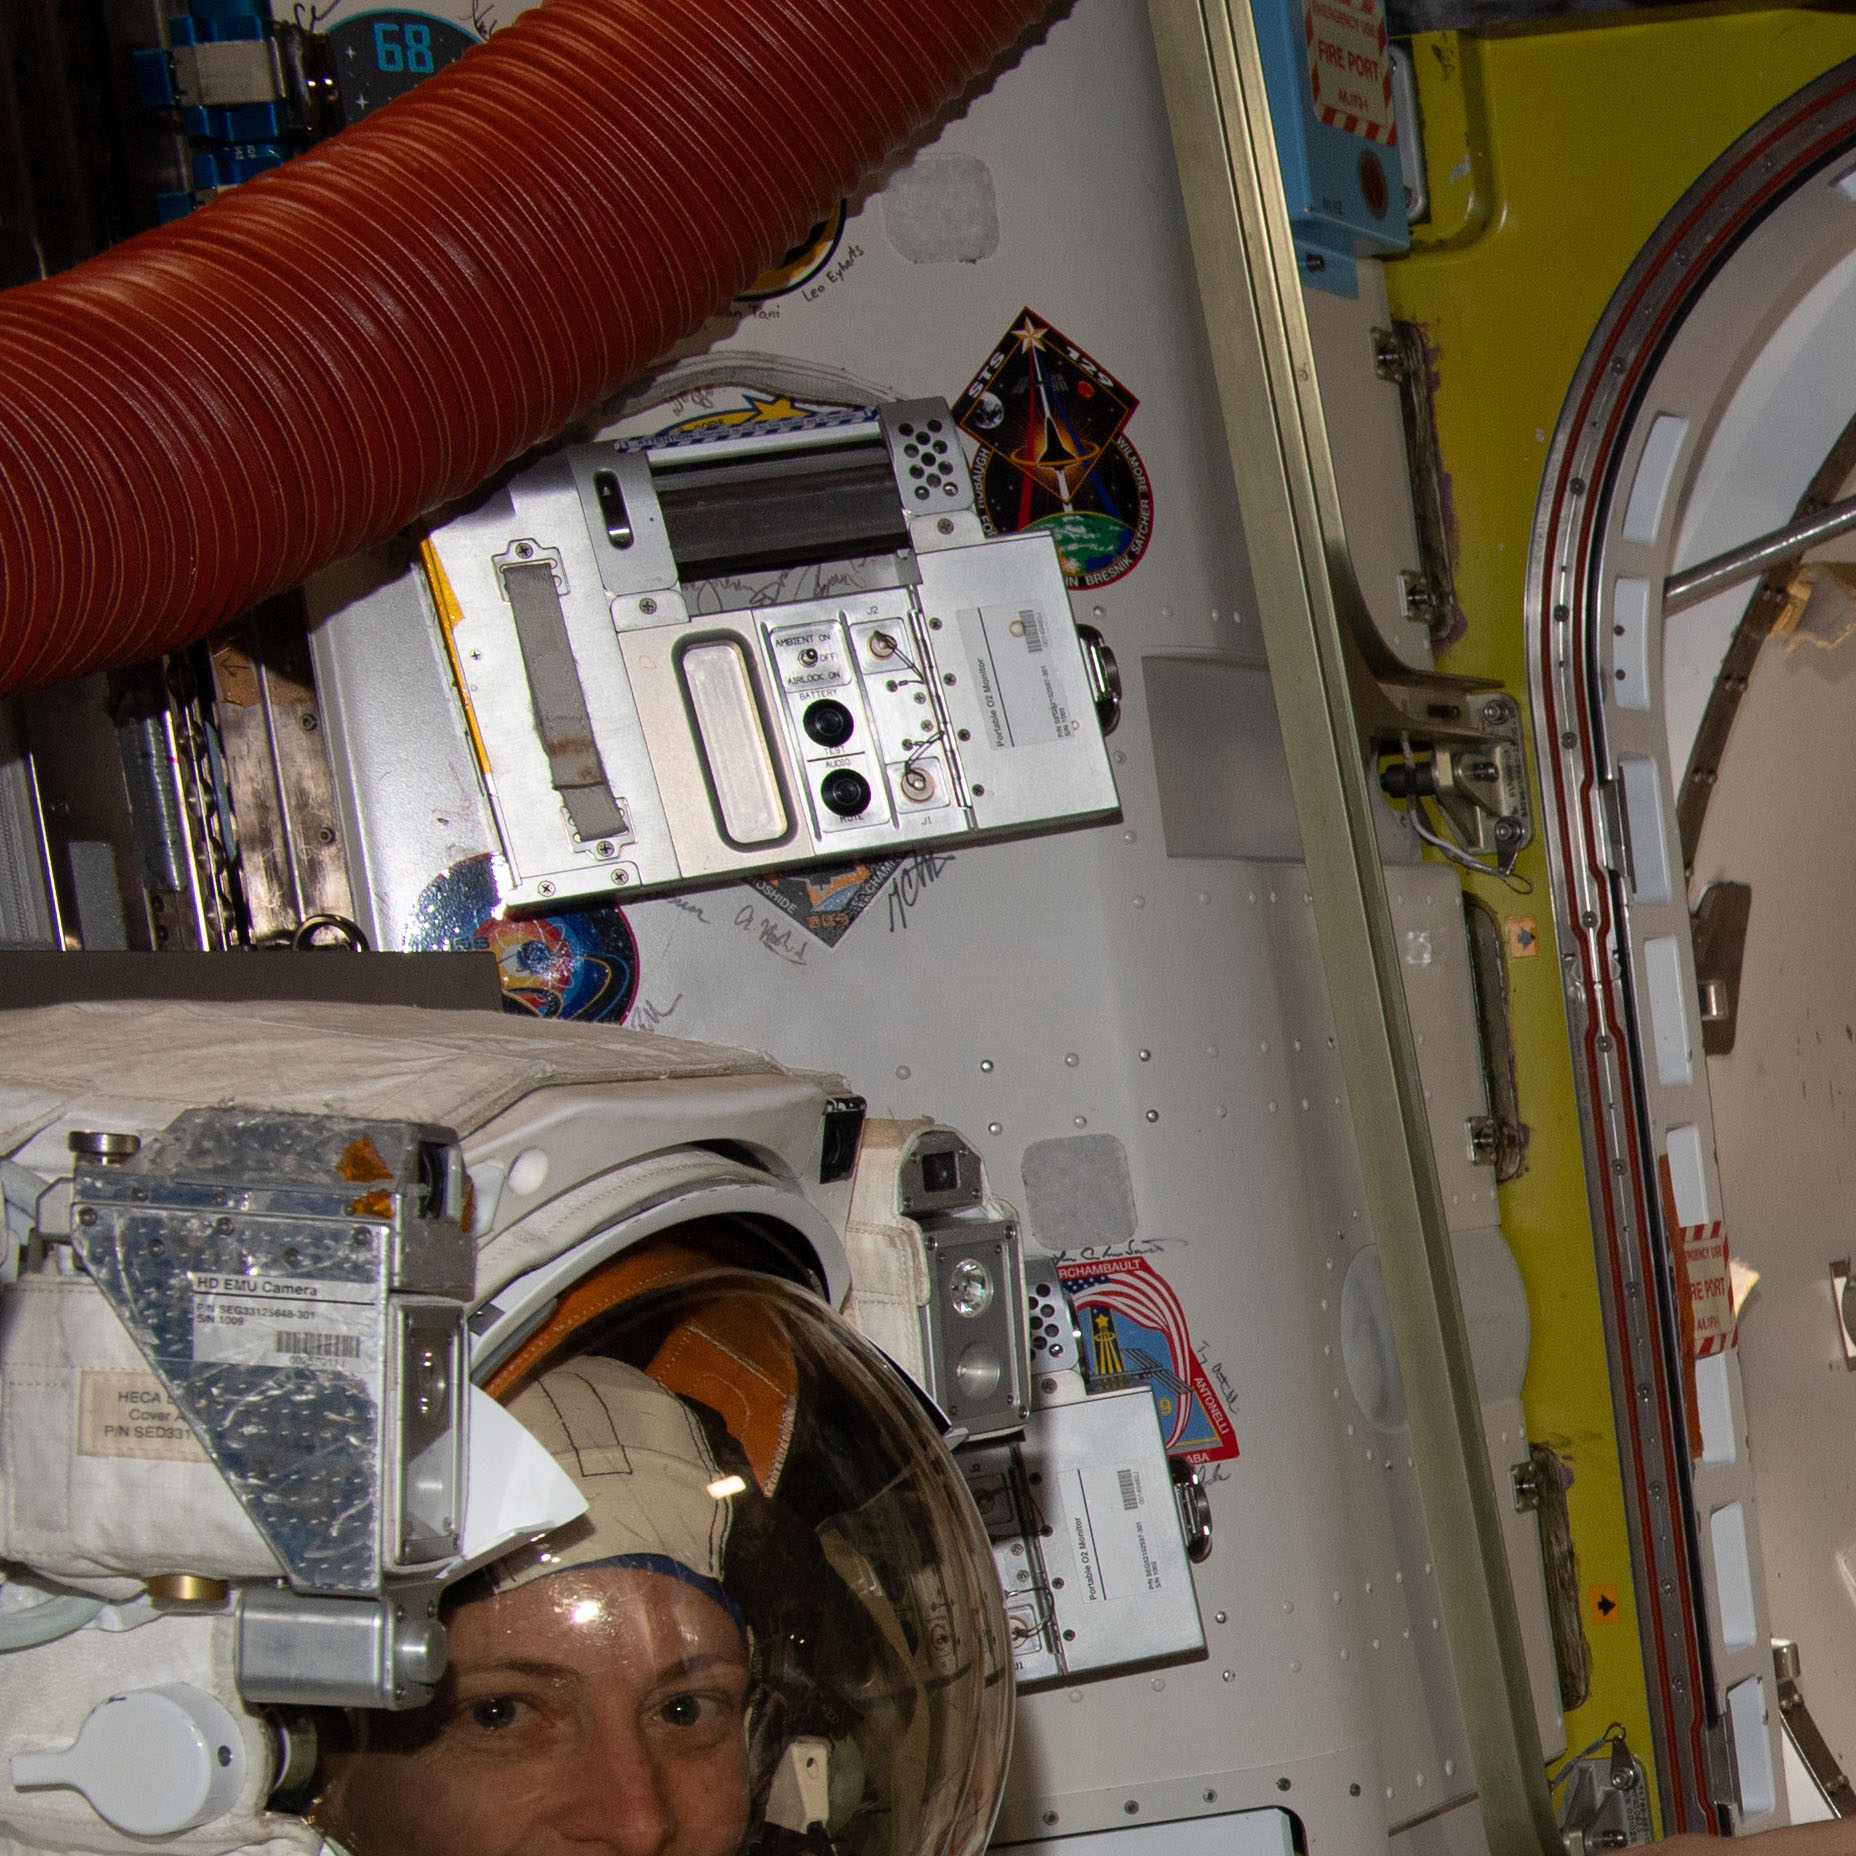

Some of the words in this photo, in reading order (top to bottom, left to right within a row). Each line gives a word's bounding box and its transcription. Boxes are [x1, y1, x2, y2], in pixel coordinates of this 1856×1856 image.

[374, 22, 433, 73] 68
[1318, 40, 1345, 70] FIRE
[1348, 51, 1378, 80] PORT
[968, 351, 1005, 399] STS
[1066, 346, 1114, 387] 129
[1116, 435, 1148, 493] WILMORE
[1131, 498, 1149, 555] SATCHER
[1085, 555, 1134, 587] BRESNIK
[866, 605, 879, 616] J2
[775, 634, 815, 648] AMBIENT
[819, 632, 831, 642] ON
[819, 653, 837, 663] OFF
[787, 673, 825, 686] AIRLOCK
[828, 671, 840, 681] ON
[977, 658, 992, 693] Monitor
[799, 689, 839, 701] BATTERY
[991, 699, 1004, 747] Portable
[823, 746, 846, 755] TEST
[825, 758, 851, 769] AUDIO
[754, 879, 797, 914] OSHIDE
[1059, 1258, 1142, 1279] RCHAMBAULT
[198, 1277, 219, 1289] HD
[224, 1279, 257, 1293] EMU
[262, 1281, 318, 1297] Camera
[1690, 1282, 1704, 1300] RE
[1704, 1277, 1725, 1299] PORT
[197, 1303, 216, 1313] P/N
[197, 1314, 216, 1324] S/N
[118, 1391, 160, 1404] HECA
[1194, 1377, 1229, 1435] ANTONELLI
[129, 1408, 169, 1421] Cover
[104, 1425, 129, 1438] P/N
[1074, 1517, 1087, 1550] Monitor
[1084, 1565, 1097, 1600] Portable
